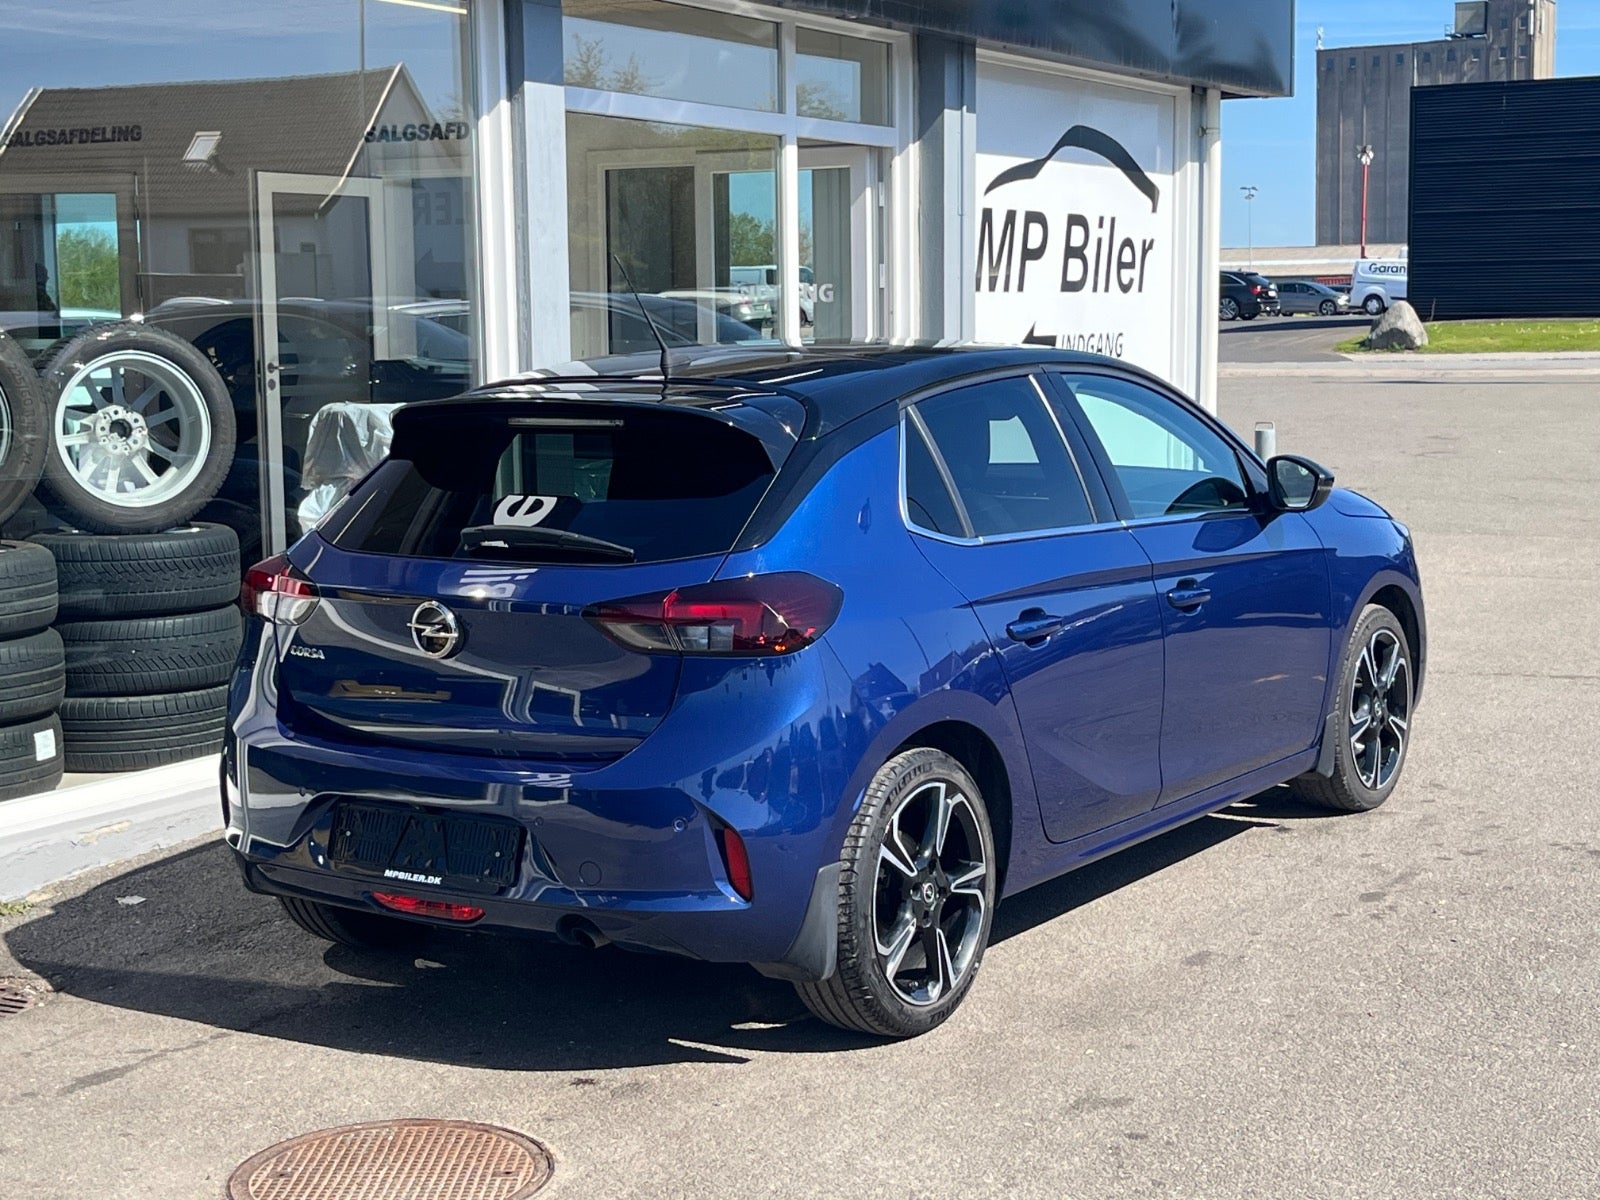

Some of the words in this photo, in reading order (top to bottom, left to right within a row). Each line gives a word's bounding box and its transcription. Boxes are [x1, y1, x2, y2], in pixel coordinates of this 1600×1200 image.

[975, 207, 1048, 293] MP
[1060, 213, 1155, 294] Biler
[1369, 262, 1406, 273] Garan
[1061, 332, 1124, 357] INDGANG
[290, 644, 326, 660] CORSA
[383, 869, 442, 885] MPBILER.DK
